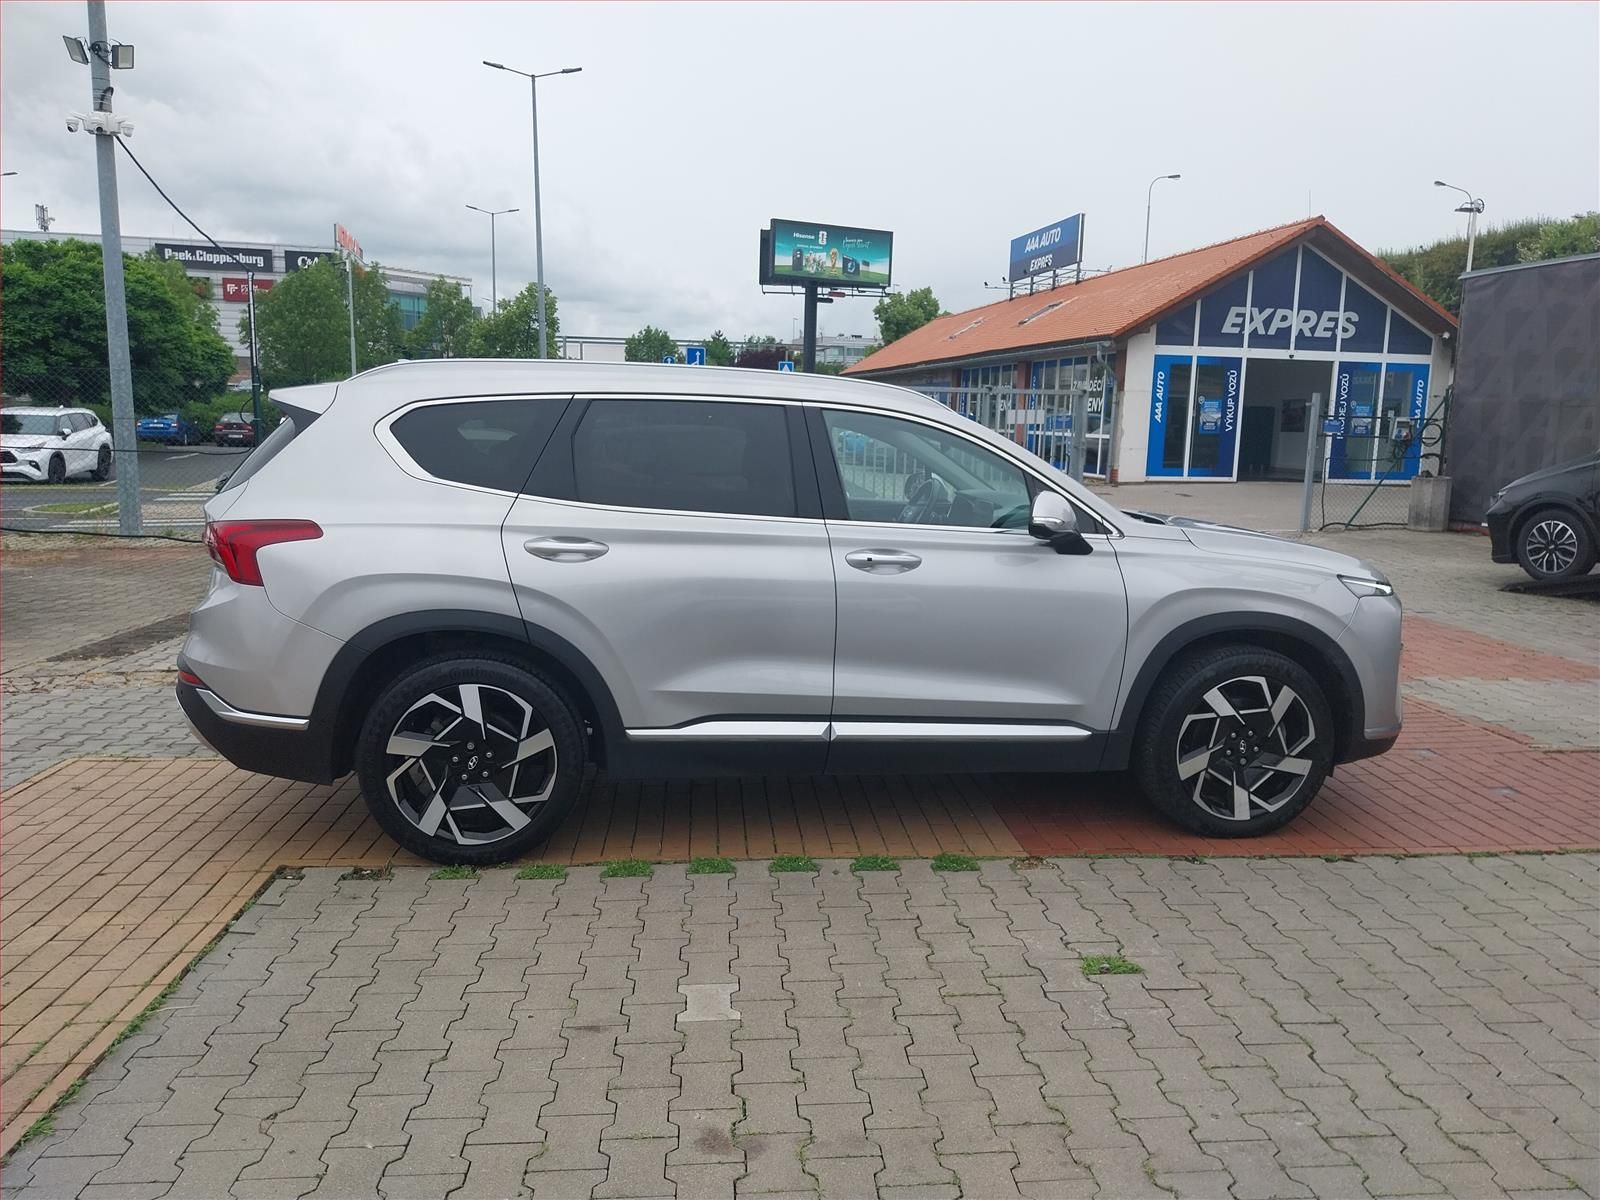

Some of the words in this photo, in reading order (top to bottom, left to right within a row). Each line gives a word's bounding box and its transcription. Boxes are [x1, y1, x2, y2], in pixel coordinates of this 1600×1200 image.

[1024, 235, 1040, 253] AAA
[1040, 227, 1062, 249] AUTO
[1029, 253, 1054, 272] EXPRES
[1221, 306, 1360, 340] EXPRES
[1155, 371, 1166, 401] AUTO
[1227, 370, 1238, 398] VOZŮ
[1340, 373, 1350, 400] VOZŮ
[1415, 379, 1425, 408] AUTO
[1154, 402, 1164, 424] AAA
[1224, 397, 1237, 432] VÝKUP
